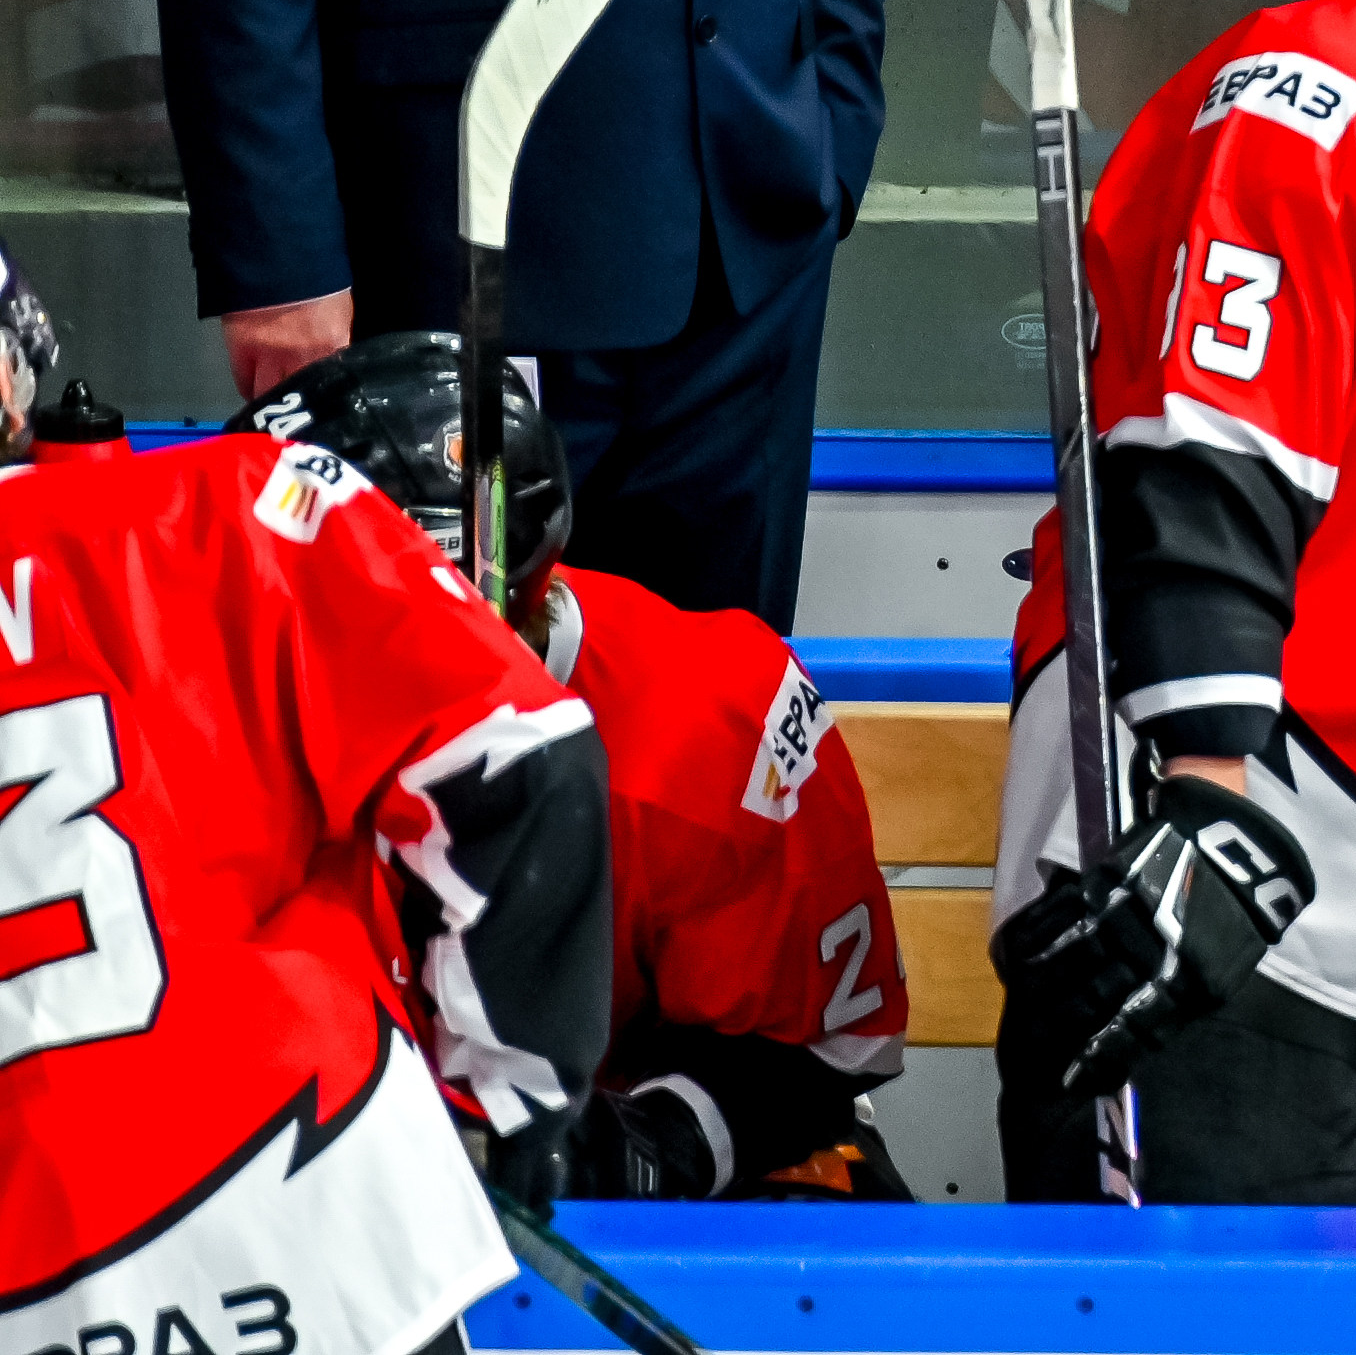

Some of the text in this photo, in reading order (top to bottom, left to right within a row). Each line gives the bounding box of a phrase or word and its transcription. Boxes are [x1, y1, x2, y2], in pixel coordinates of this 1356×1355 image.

[1159, 239, 1284, 383] 3
[252, 391, 313, 444] 24
[819, 901, 906, 1032] 2
